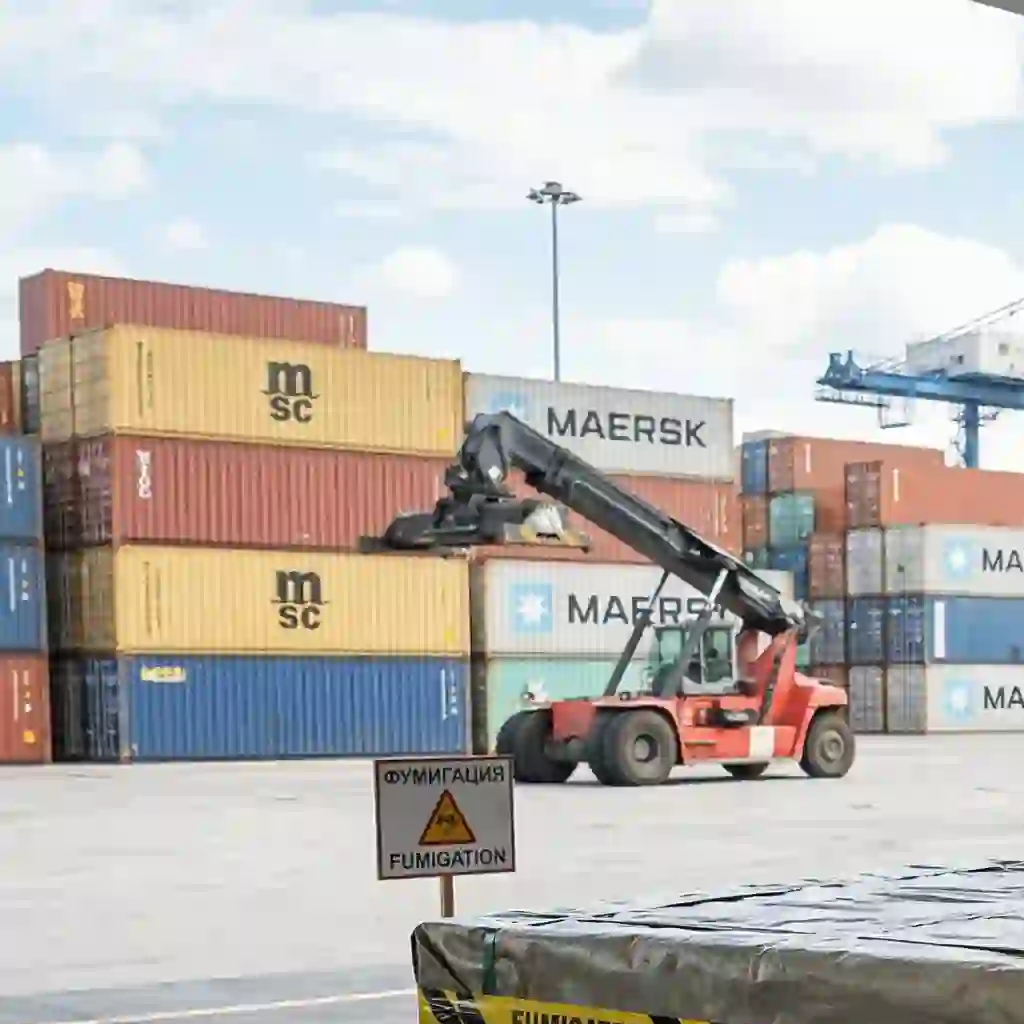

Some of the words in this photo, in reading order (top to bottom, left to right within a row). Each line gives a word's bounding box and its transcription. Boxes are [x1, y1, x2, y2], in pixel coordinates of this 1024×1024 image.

[547, 407, 708, 448] MAERSK
[384, 764, 505, 787] ФУМИГАЦИЯ
[390, 847, 507, 870] FUMIGATION
